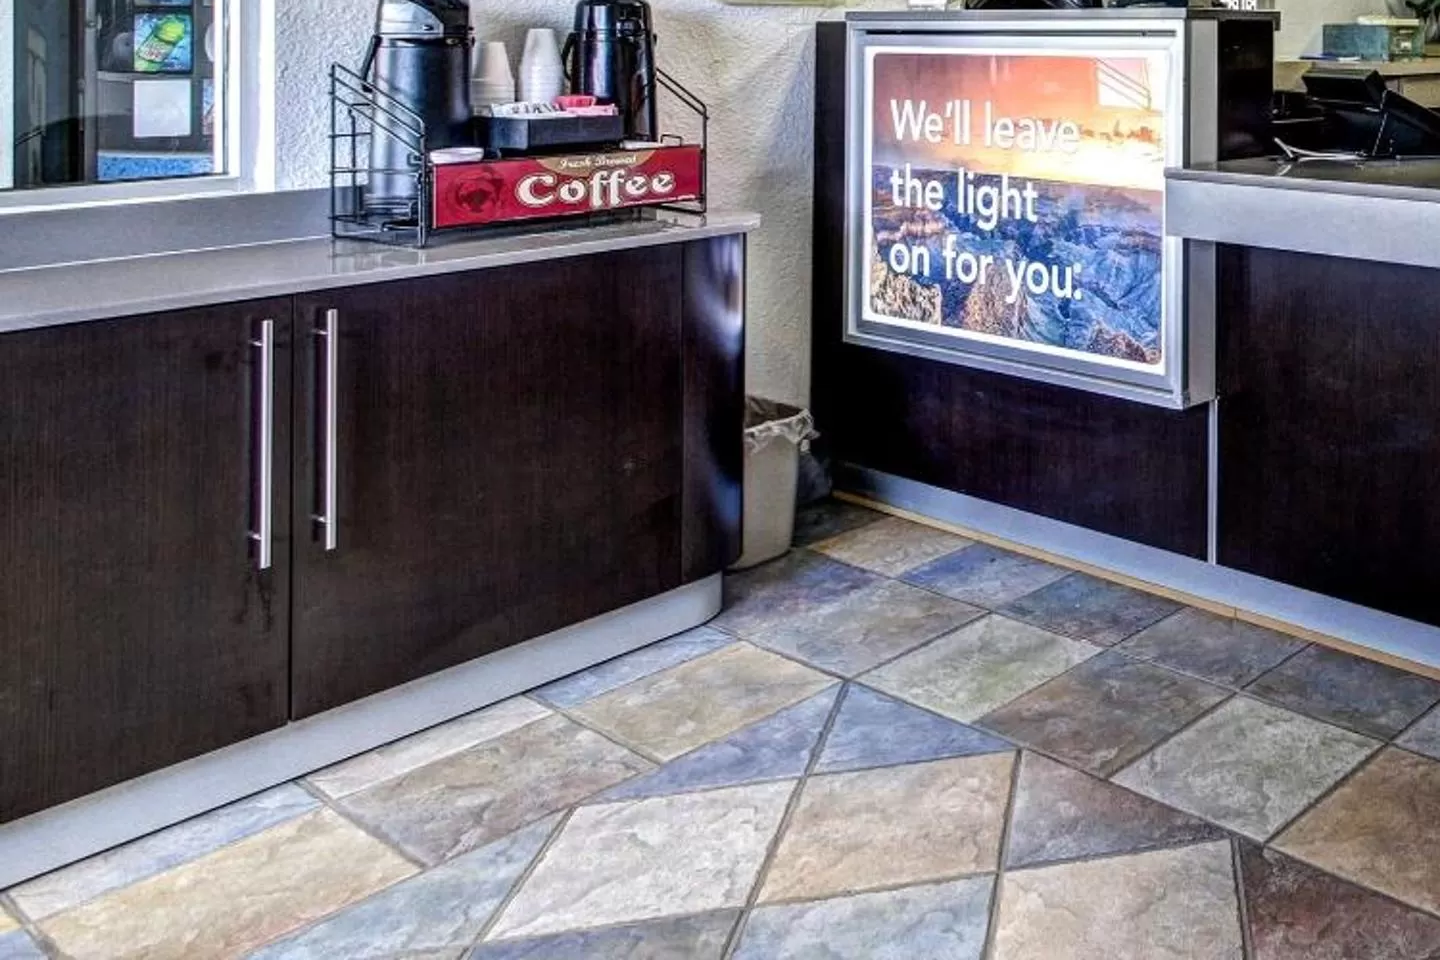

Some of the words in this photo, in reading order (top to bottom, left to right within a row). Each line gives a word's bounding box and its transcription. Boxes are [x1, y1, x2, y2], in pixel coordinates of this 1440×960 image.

[889, 99, 971, 145] We'll
[984, 100, 1080, 153] leave
[516, 168, 674, 208] Coffee
[889, 163, 944, 211] the
[957, 167, 1038, 231] light
[889, 242, 930, 277] on
[942, 234, 994, 285] for
